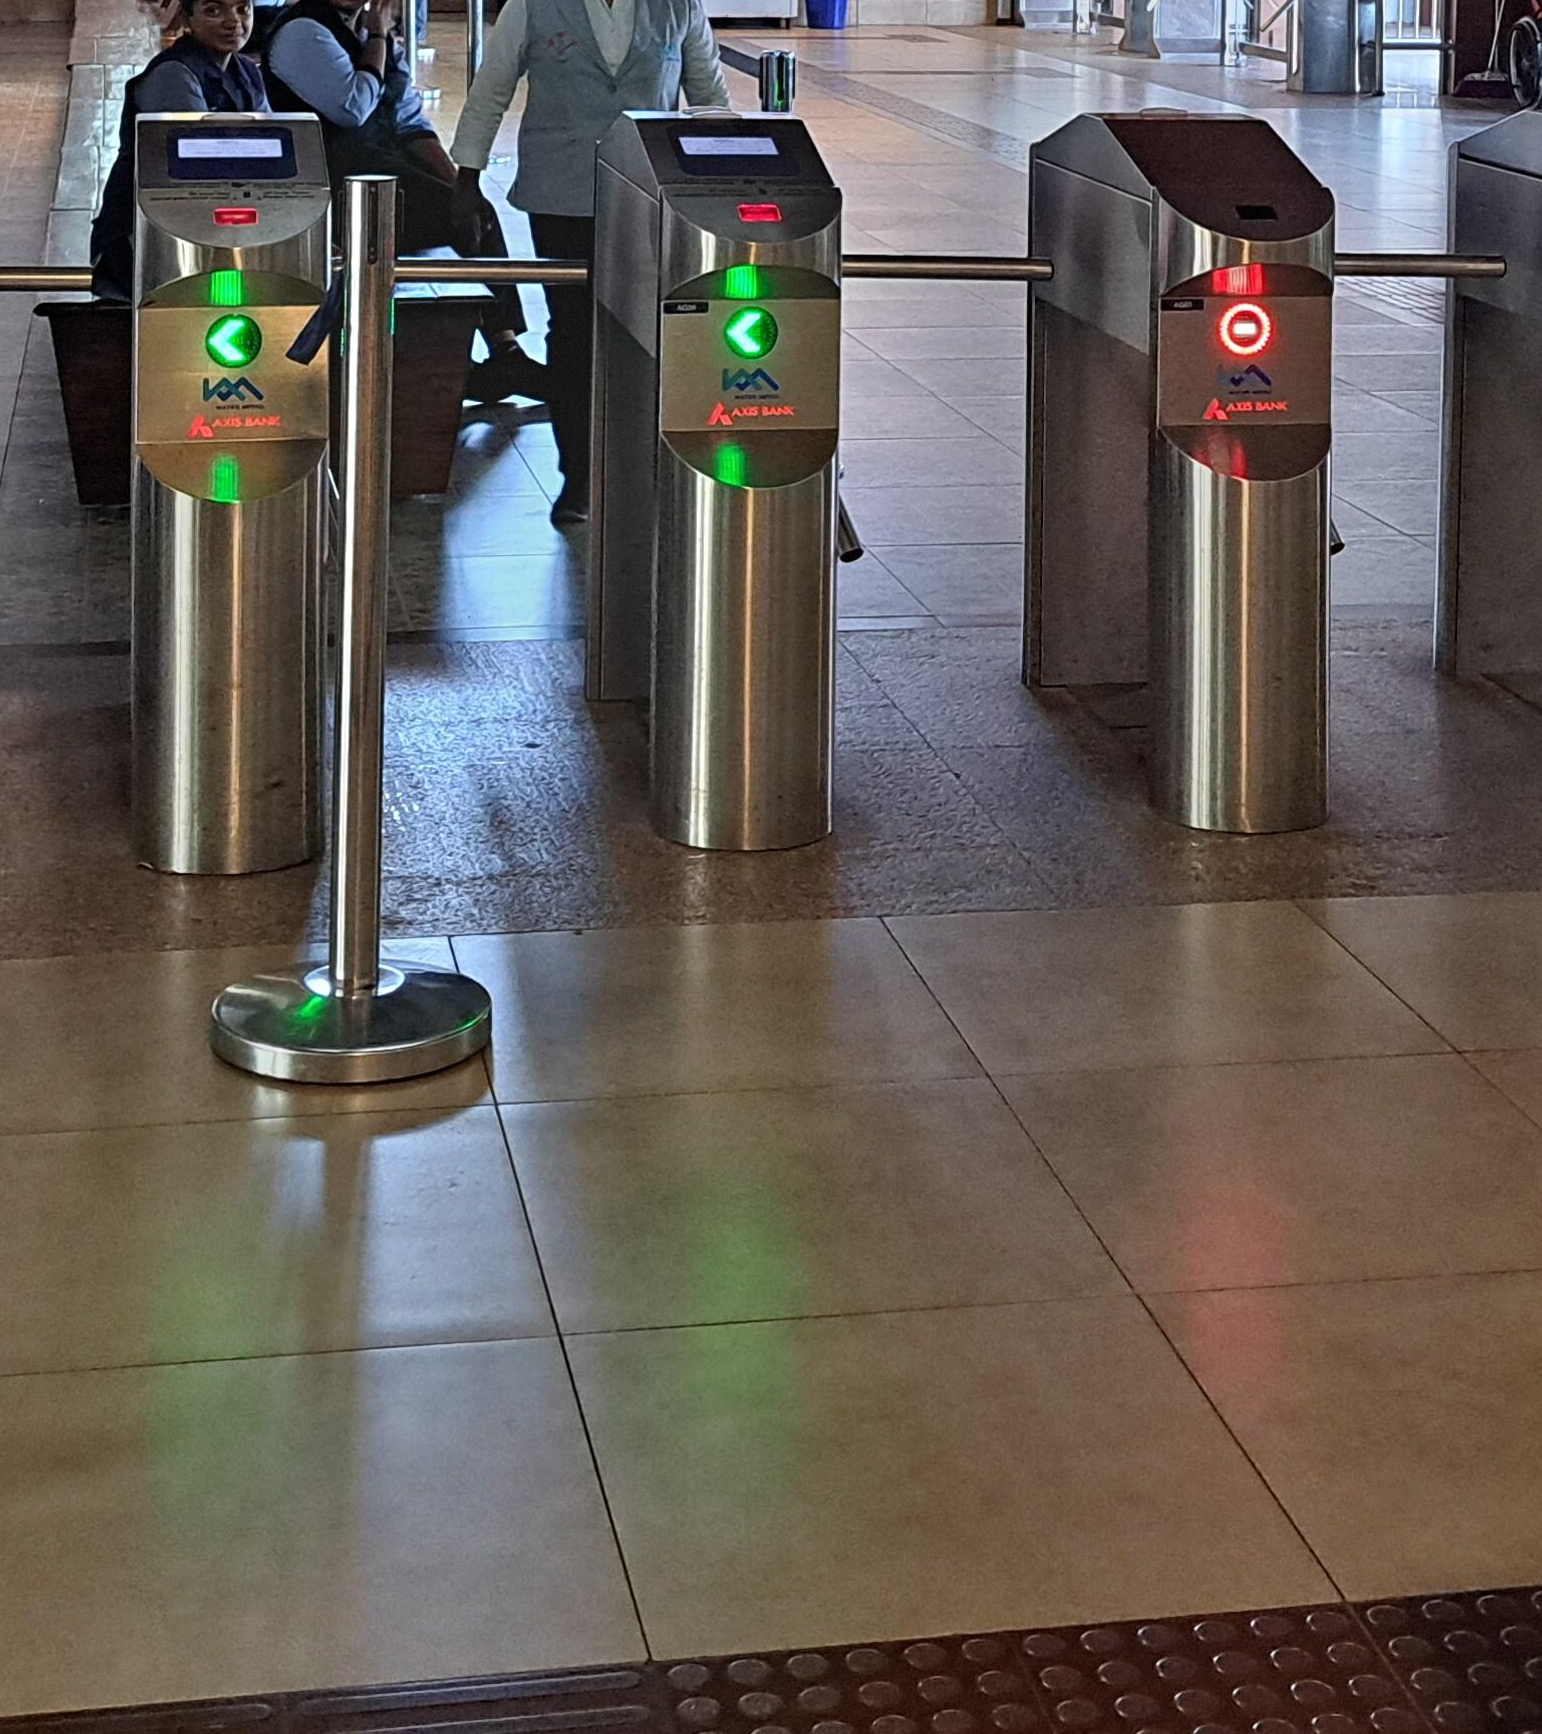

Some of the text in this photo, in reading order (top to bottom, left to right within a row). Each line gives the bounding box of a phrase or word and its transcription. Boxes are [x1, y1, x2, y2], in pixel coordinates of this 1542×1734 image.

[731, 404, 795, 418] AXIS BANK
[1226, 400, 1289, 412] AXIS BANK
[212, 415, 281, 428] AXIS BANK
